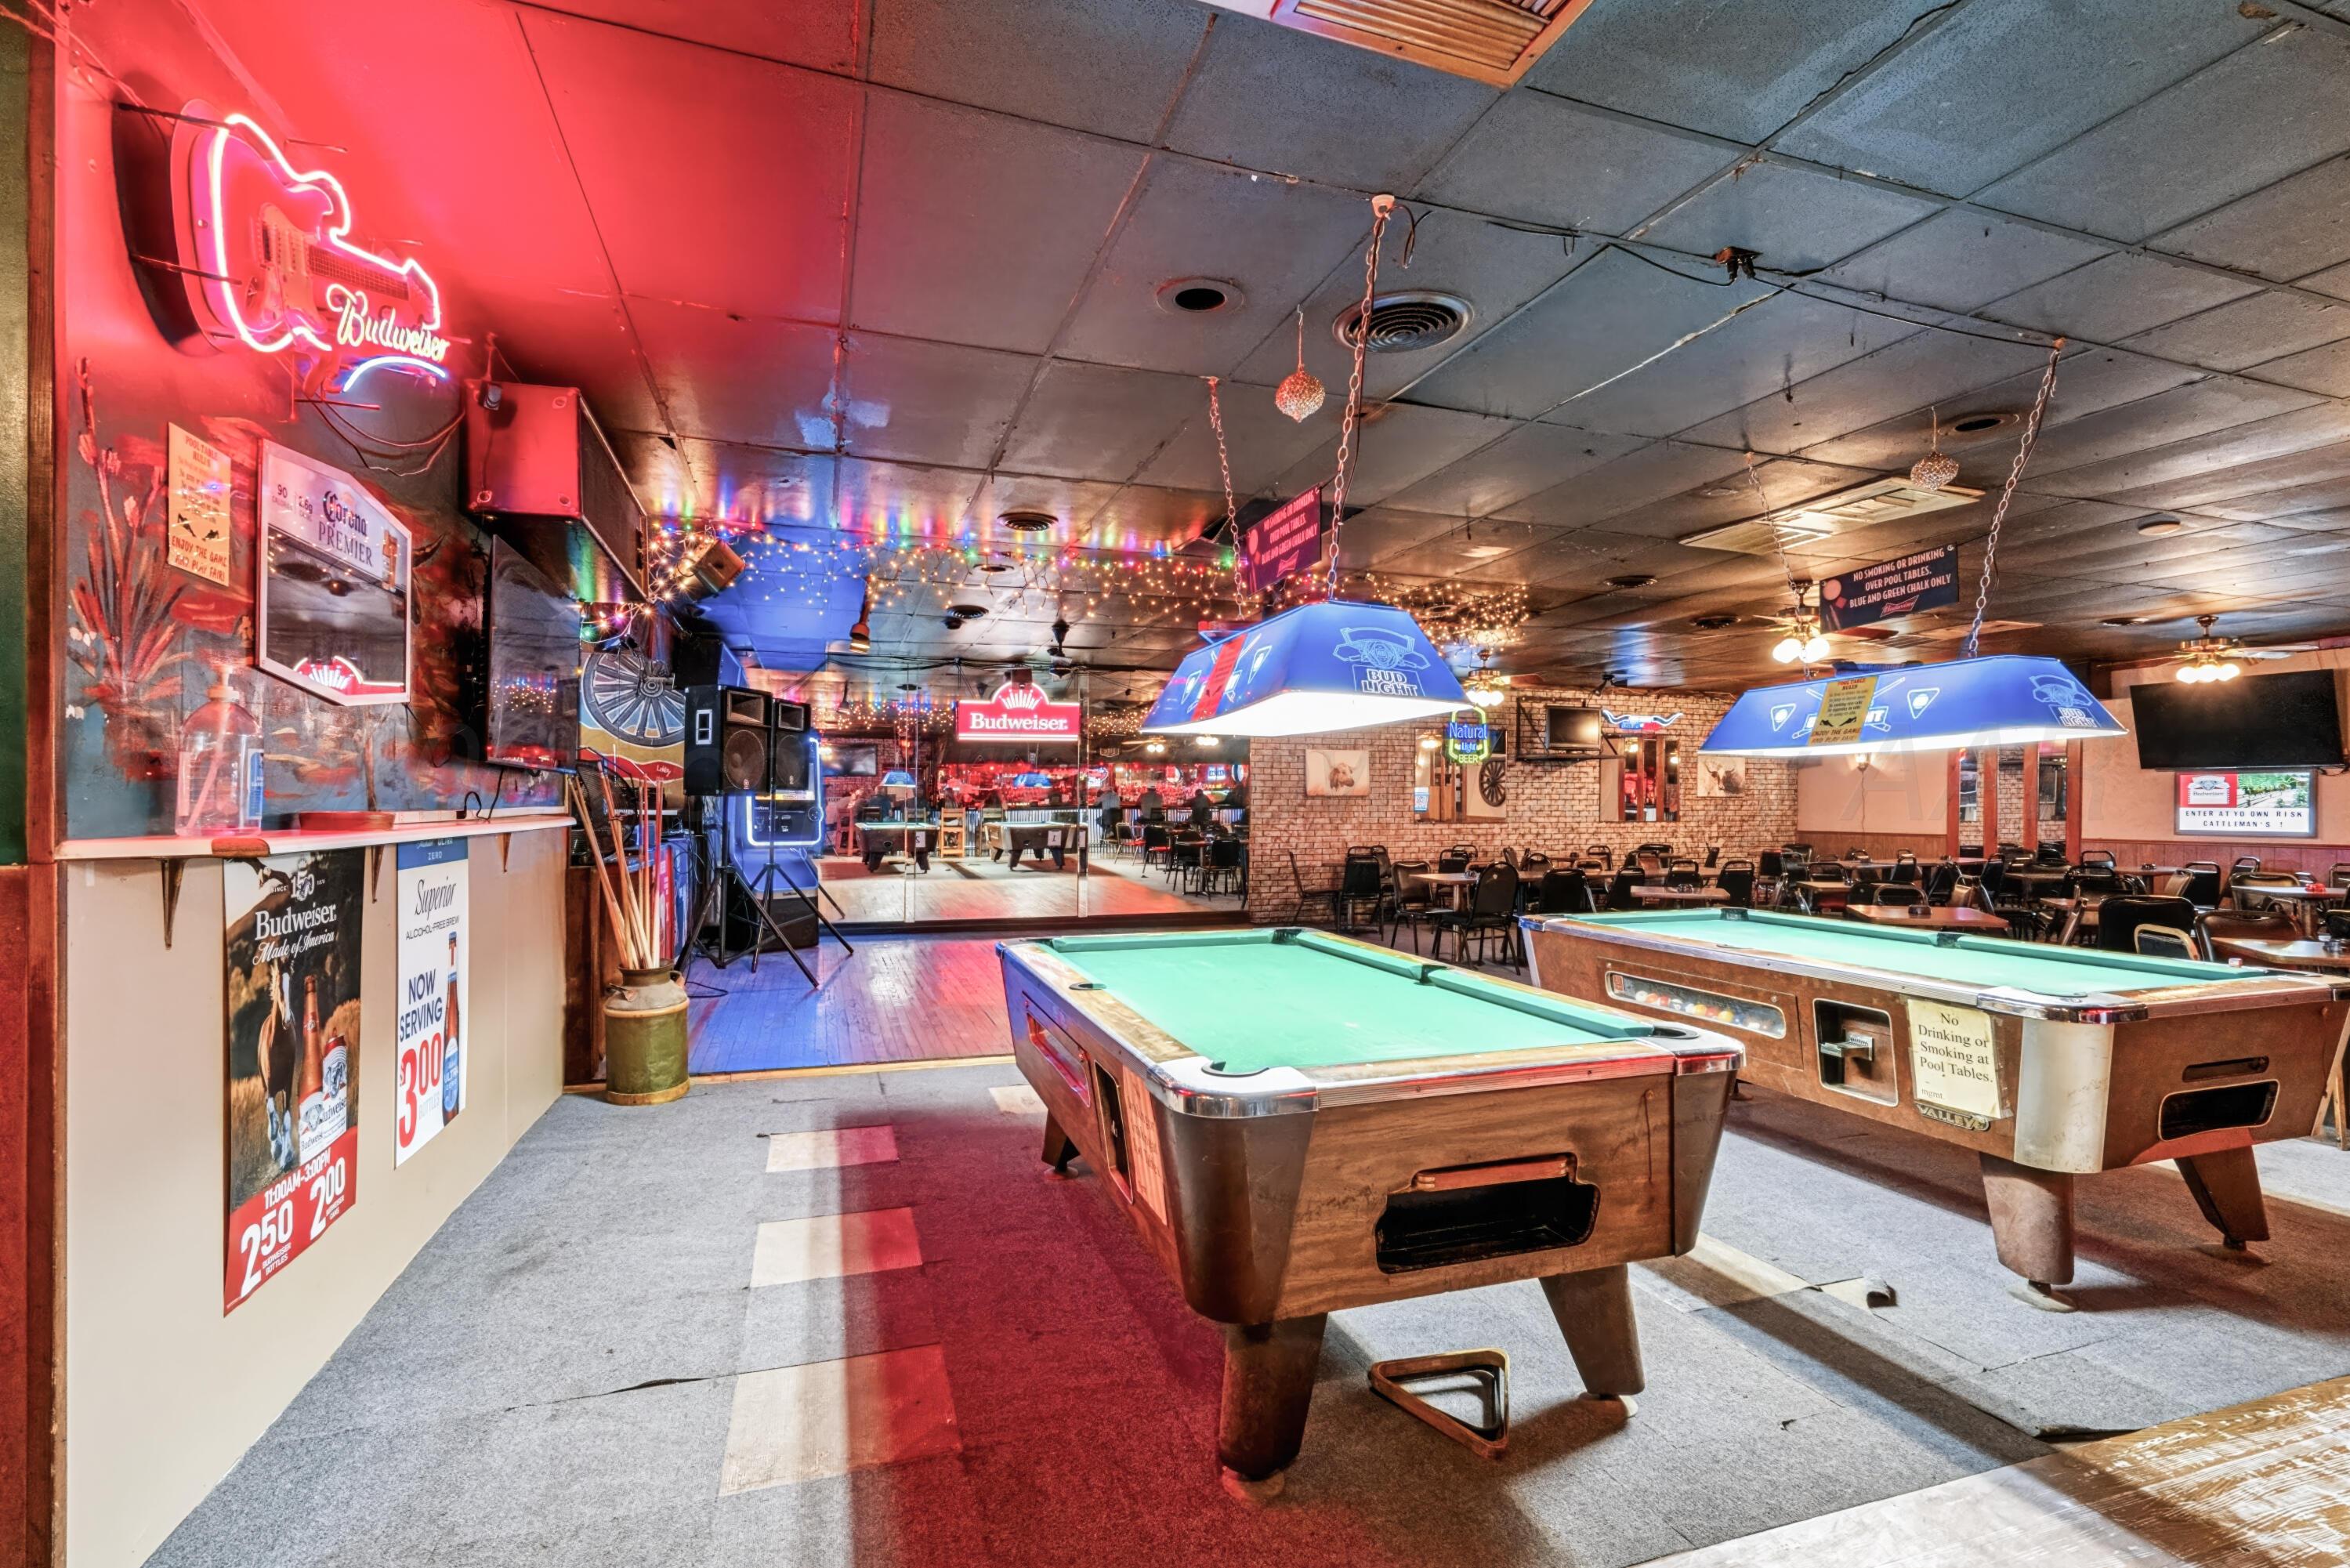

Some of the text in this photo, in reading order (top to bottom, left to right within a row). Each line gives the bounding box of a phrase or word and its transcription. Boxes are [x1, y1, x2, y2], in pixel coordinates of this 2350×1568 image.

[326, 283, 451, 362] Budweiser
[277, 484, 288, 498] 90
[323, 491, 368, 537] Corona
[1263, 490, 1314, 532] NO SMOKING OR DRINKING
[319, 521, 373, 567] PREMIER
[1262, 550, 1270, 564] BLUE
[1270, 546, 1279, 559] AND
[1279, 538, 1292, 555] GREEN
[1292, 531, 1305, 548] CHALK
[1305, 523, 1317, 541] ONLY
[1269, 529, 1280, 544] OVER
[1280, 523, 1290, 538] POOL
[172, 535, 227, 567] ENJOY THE GAME
[1853, 548, 1945, 582] NO SMOKING OR DRINKING
[1865, 565, 1932, 592] OVER POOL TABLES.
[1849, 573, 1952, 608] BLUE AND GREEN CHALK ONLY
[1361, 679, 1418, 696] LIGHT
[1367, 668, 1407, 685] BUD
[2058, 707, 2085, 718] BUD
[2059, 716, 2098, 727] LIGHT
[1449, 722, 1487, 739] Natural
[1458, 754, 1479, 763] BEER
[428, 851, 443, 860] ZERO
[415, 875, 456, 921] Superior
[255, 902, 336, 940] Budweiser
[446, 915, 460, 927] BREW
[252, 929, 335, 965] Made of America
[408, 969, 436, 1005] NOW
[400, 997, 443, 1043] SERVING
[1940, 1012, 1959, 1026] No
[1918, 1024, 1990, 1048] Drinking or
[1921, 1041, 1990, 1065] Smoking at
[1920, 1056, 1993, 1083] Pool Tables.
[1917, 1104, 1977, 1130] VALLEY
[310, 1157, 346, 1240] 200
[241, 1199, 293, 1298] 250
[263, 1243, 291, 1269] BUDWEISER
[266, 1254, 288, 1276] BOTTLES
